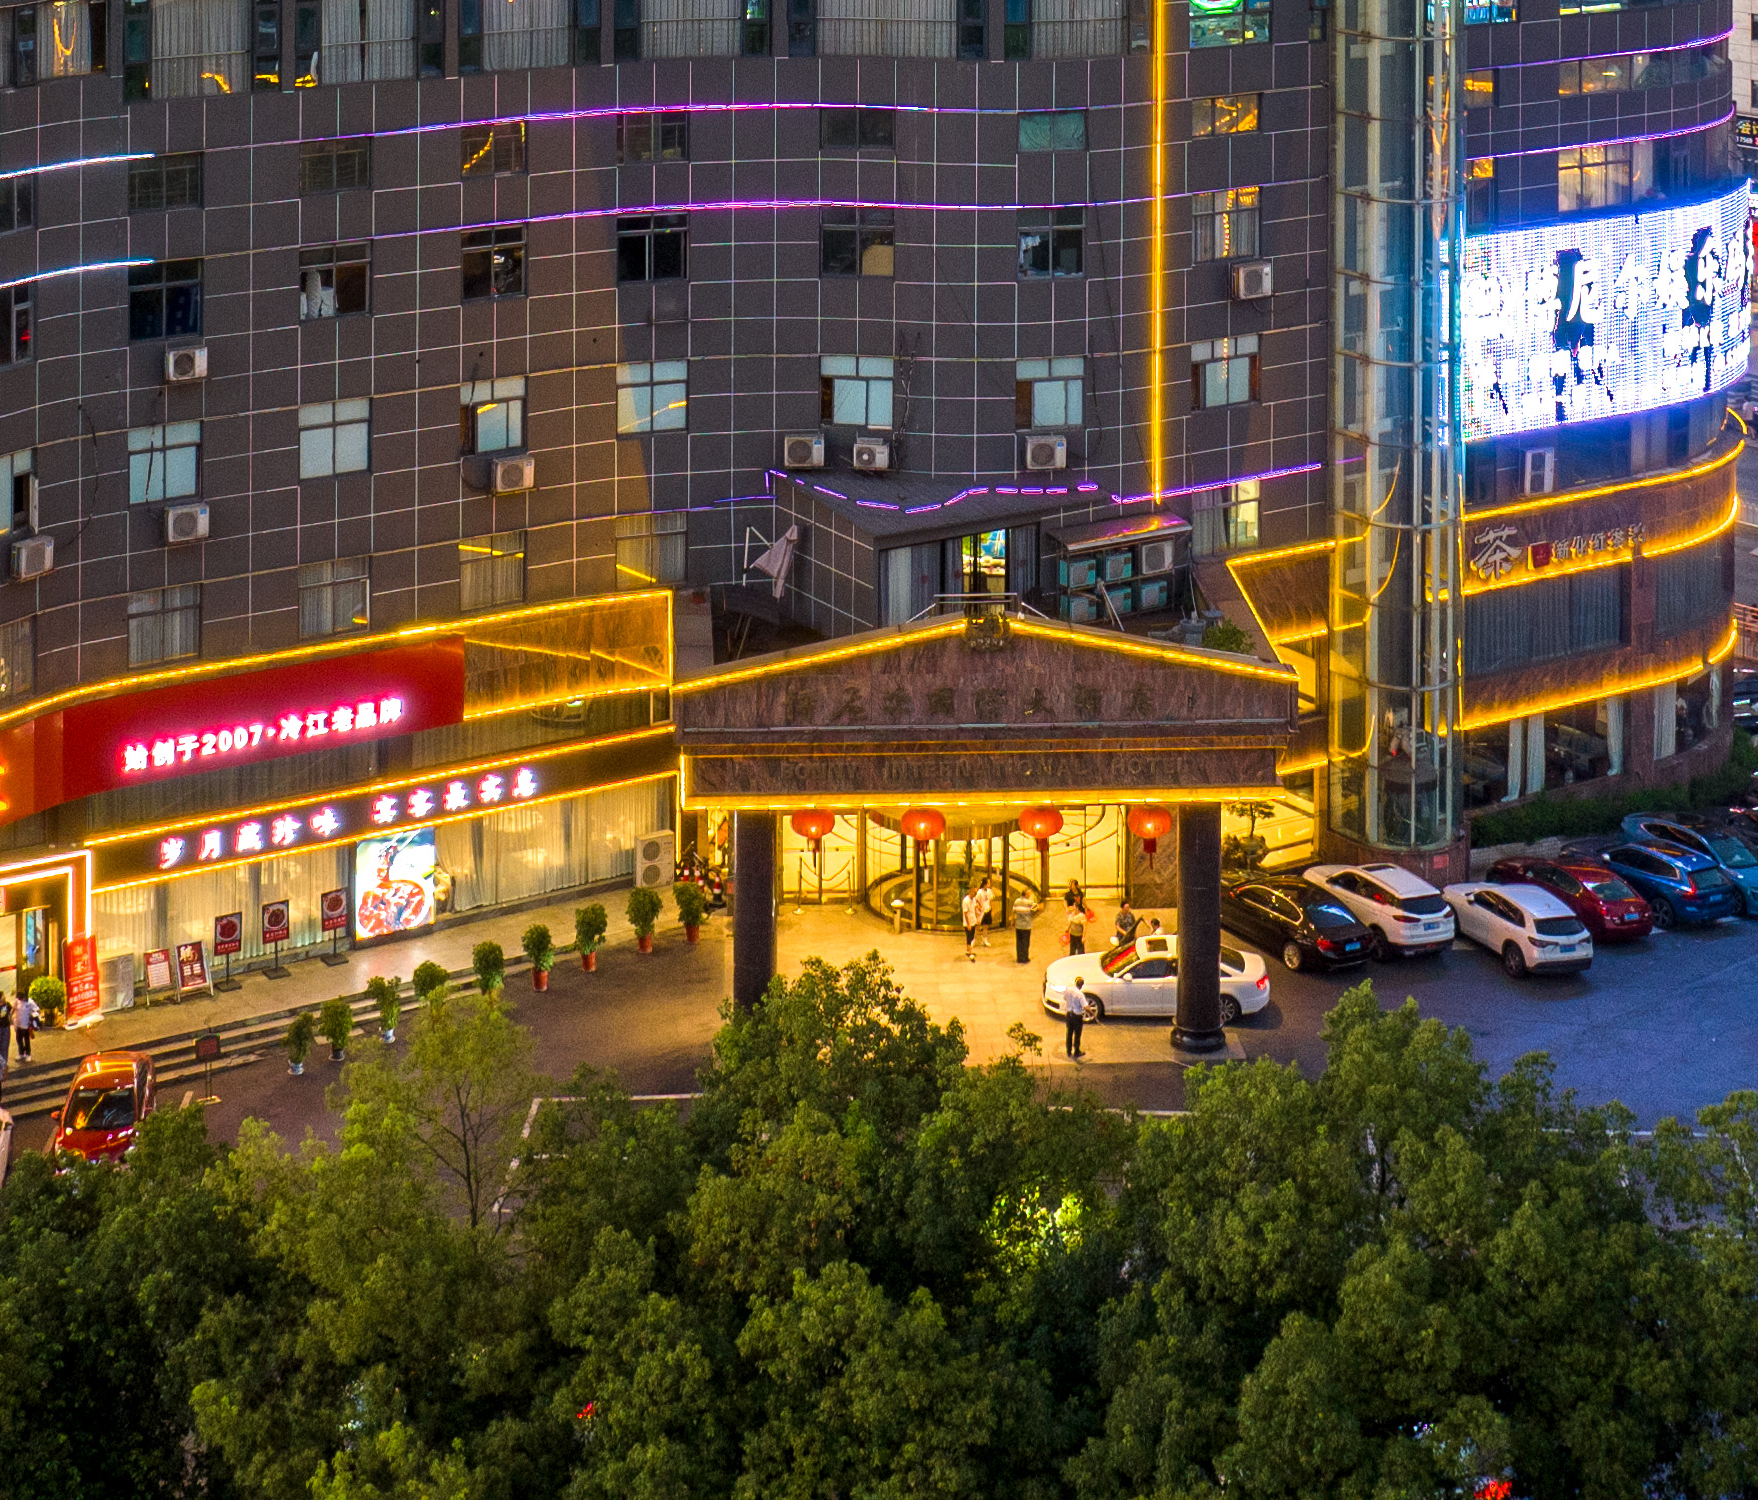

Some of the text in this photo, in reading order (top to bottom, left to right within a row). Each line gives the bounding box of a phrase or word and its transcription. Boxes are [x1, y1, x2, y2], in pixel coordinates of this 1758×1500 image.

[1471, 524, 1522, 579] 茶
[123, 698, 403, 771] 始创于2007·冷江老品牌
